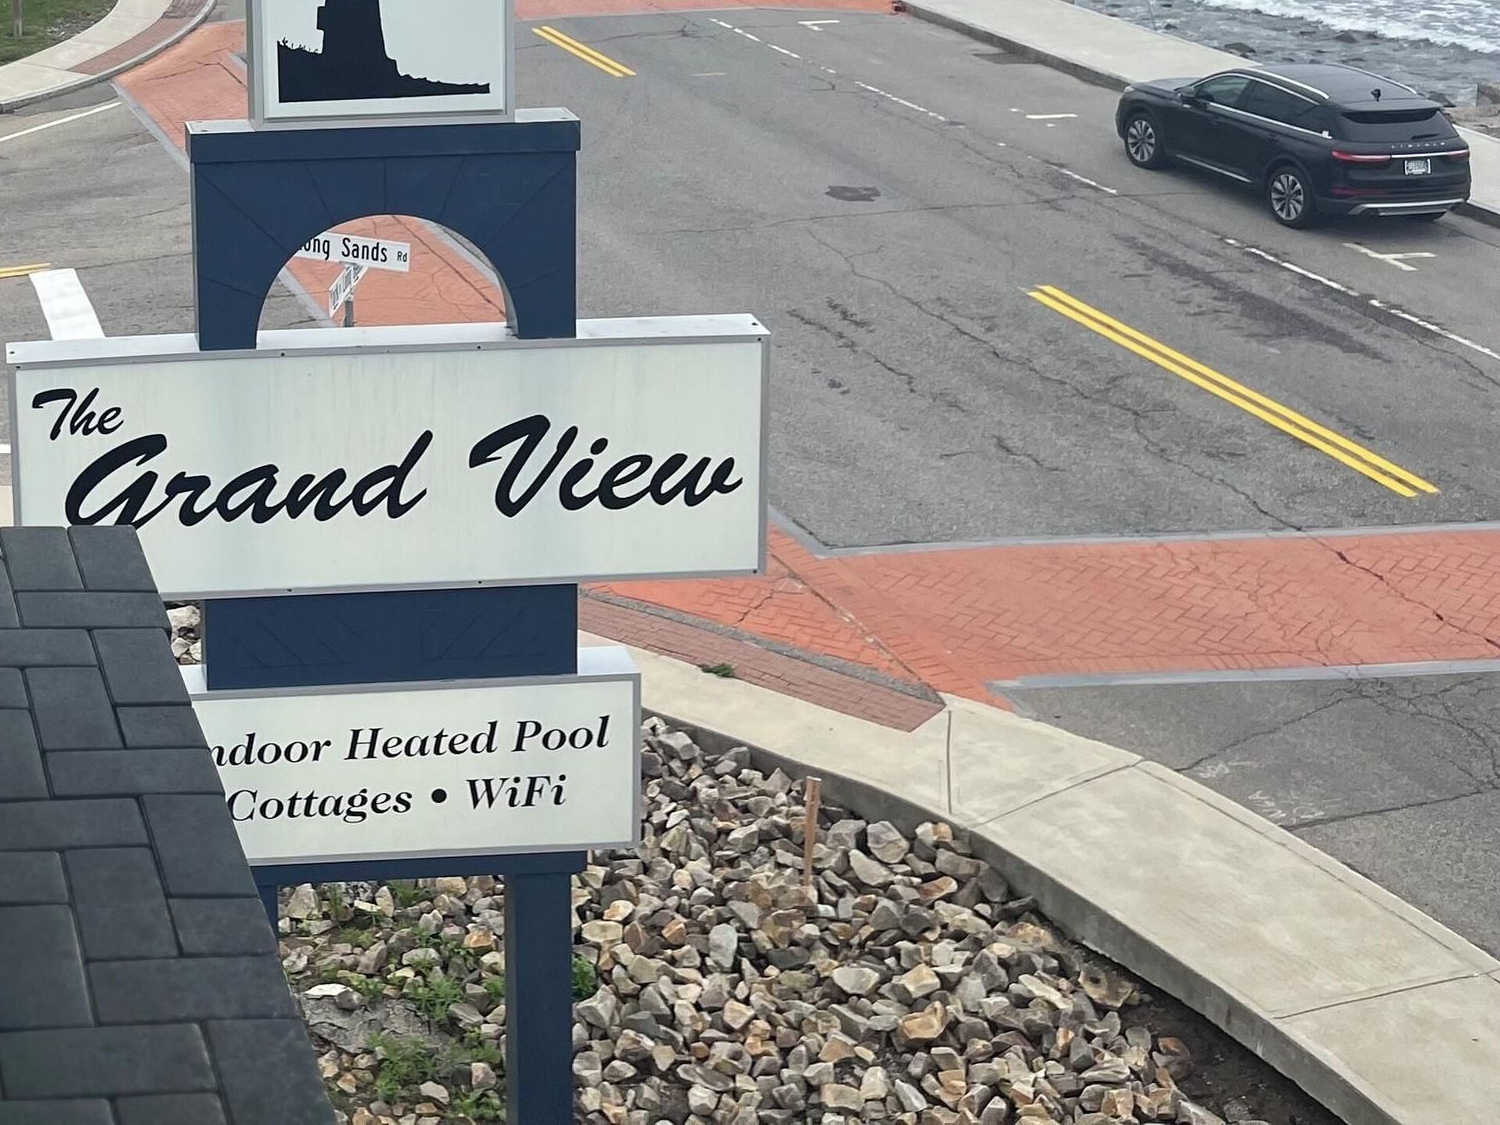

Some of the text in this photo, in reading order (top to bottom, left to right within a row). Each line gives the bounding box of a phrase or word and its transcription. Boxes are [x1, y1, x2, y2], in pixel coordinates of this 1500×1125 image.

[300, 237, 408, 263] ong Sands Rd
[31, 387, 125, 441] The
[64, 414, 744, 530] Grand View
[210, 714, 611, 767] ndoor Heated Pool
[226, 773, 567, 824] Cottages WiFi
